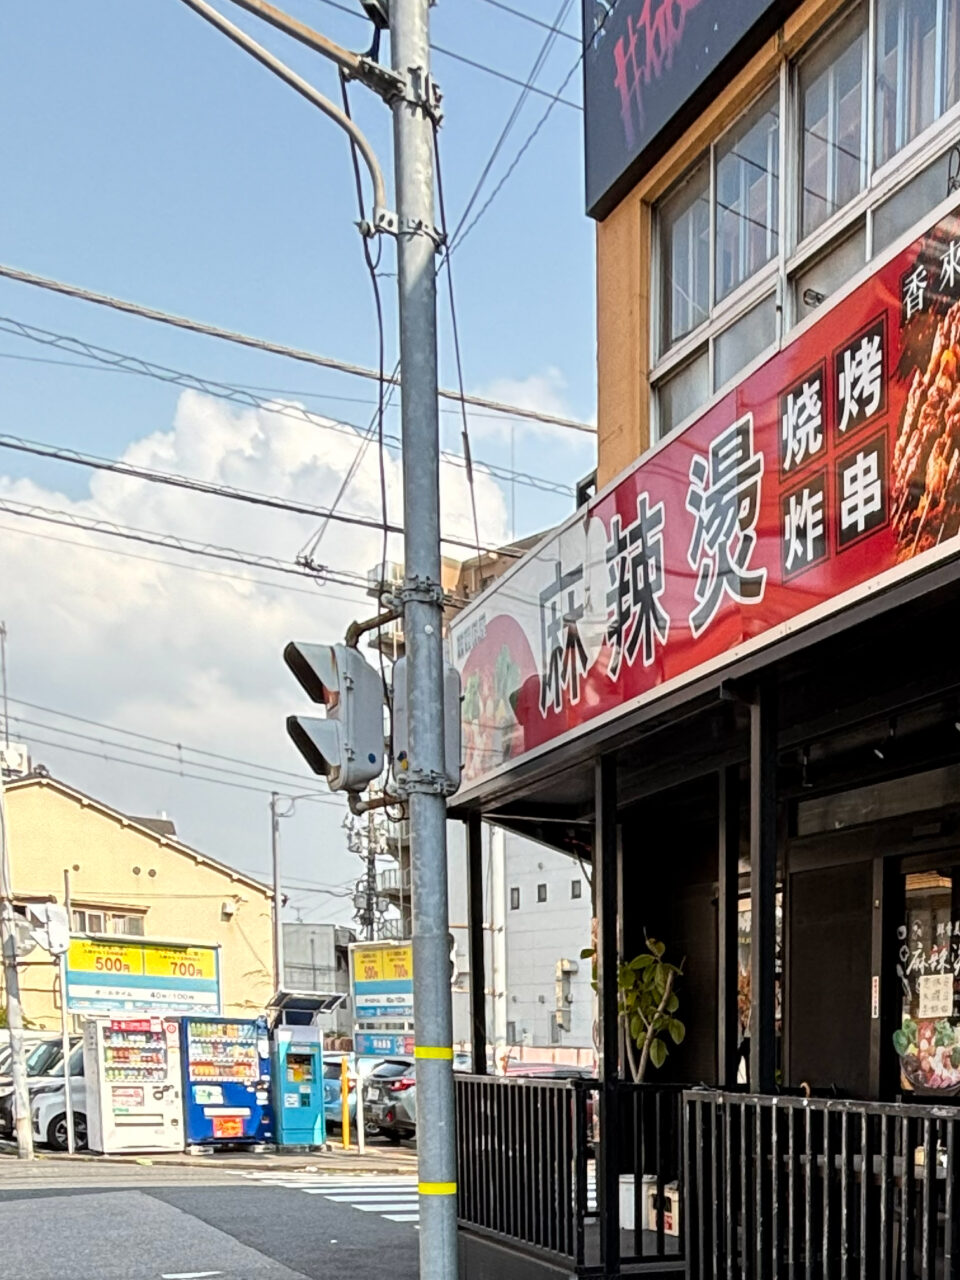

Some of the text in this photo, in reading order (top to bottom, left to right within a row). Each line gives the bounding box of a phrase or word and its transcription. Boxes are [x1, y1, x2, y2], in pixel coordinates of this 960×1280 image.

[781, 334, 884, 470] 烧烤
[539, 412, 768, 719] 麻辣燙
[784, 451, 884, 571] 炸串
